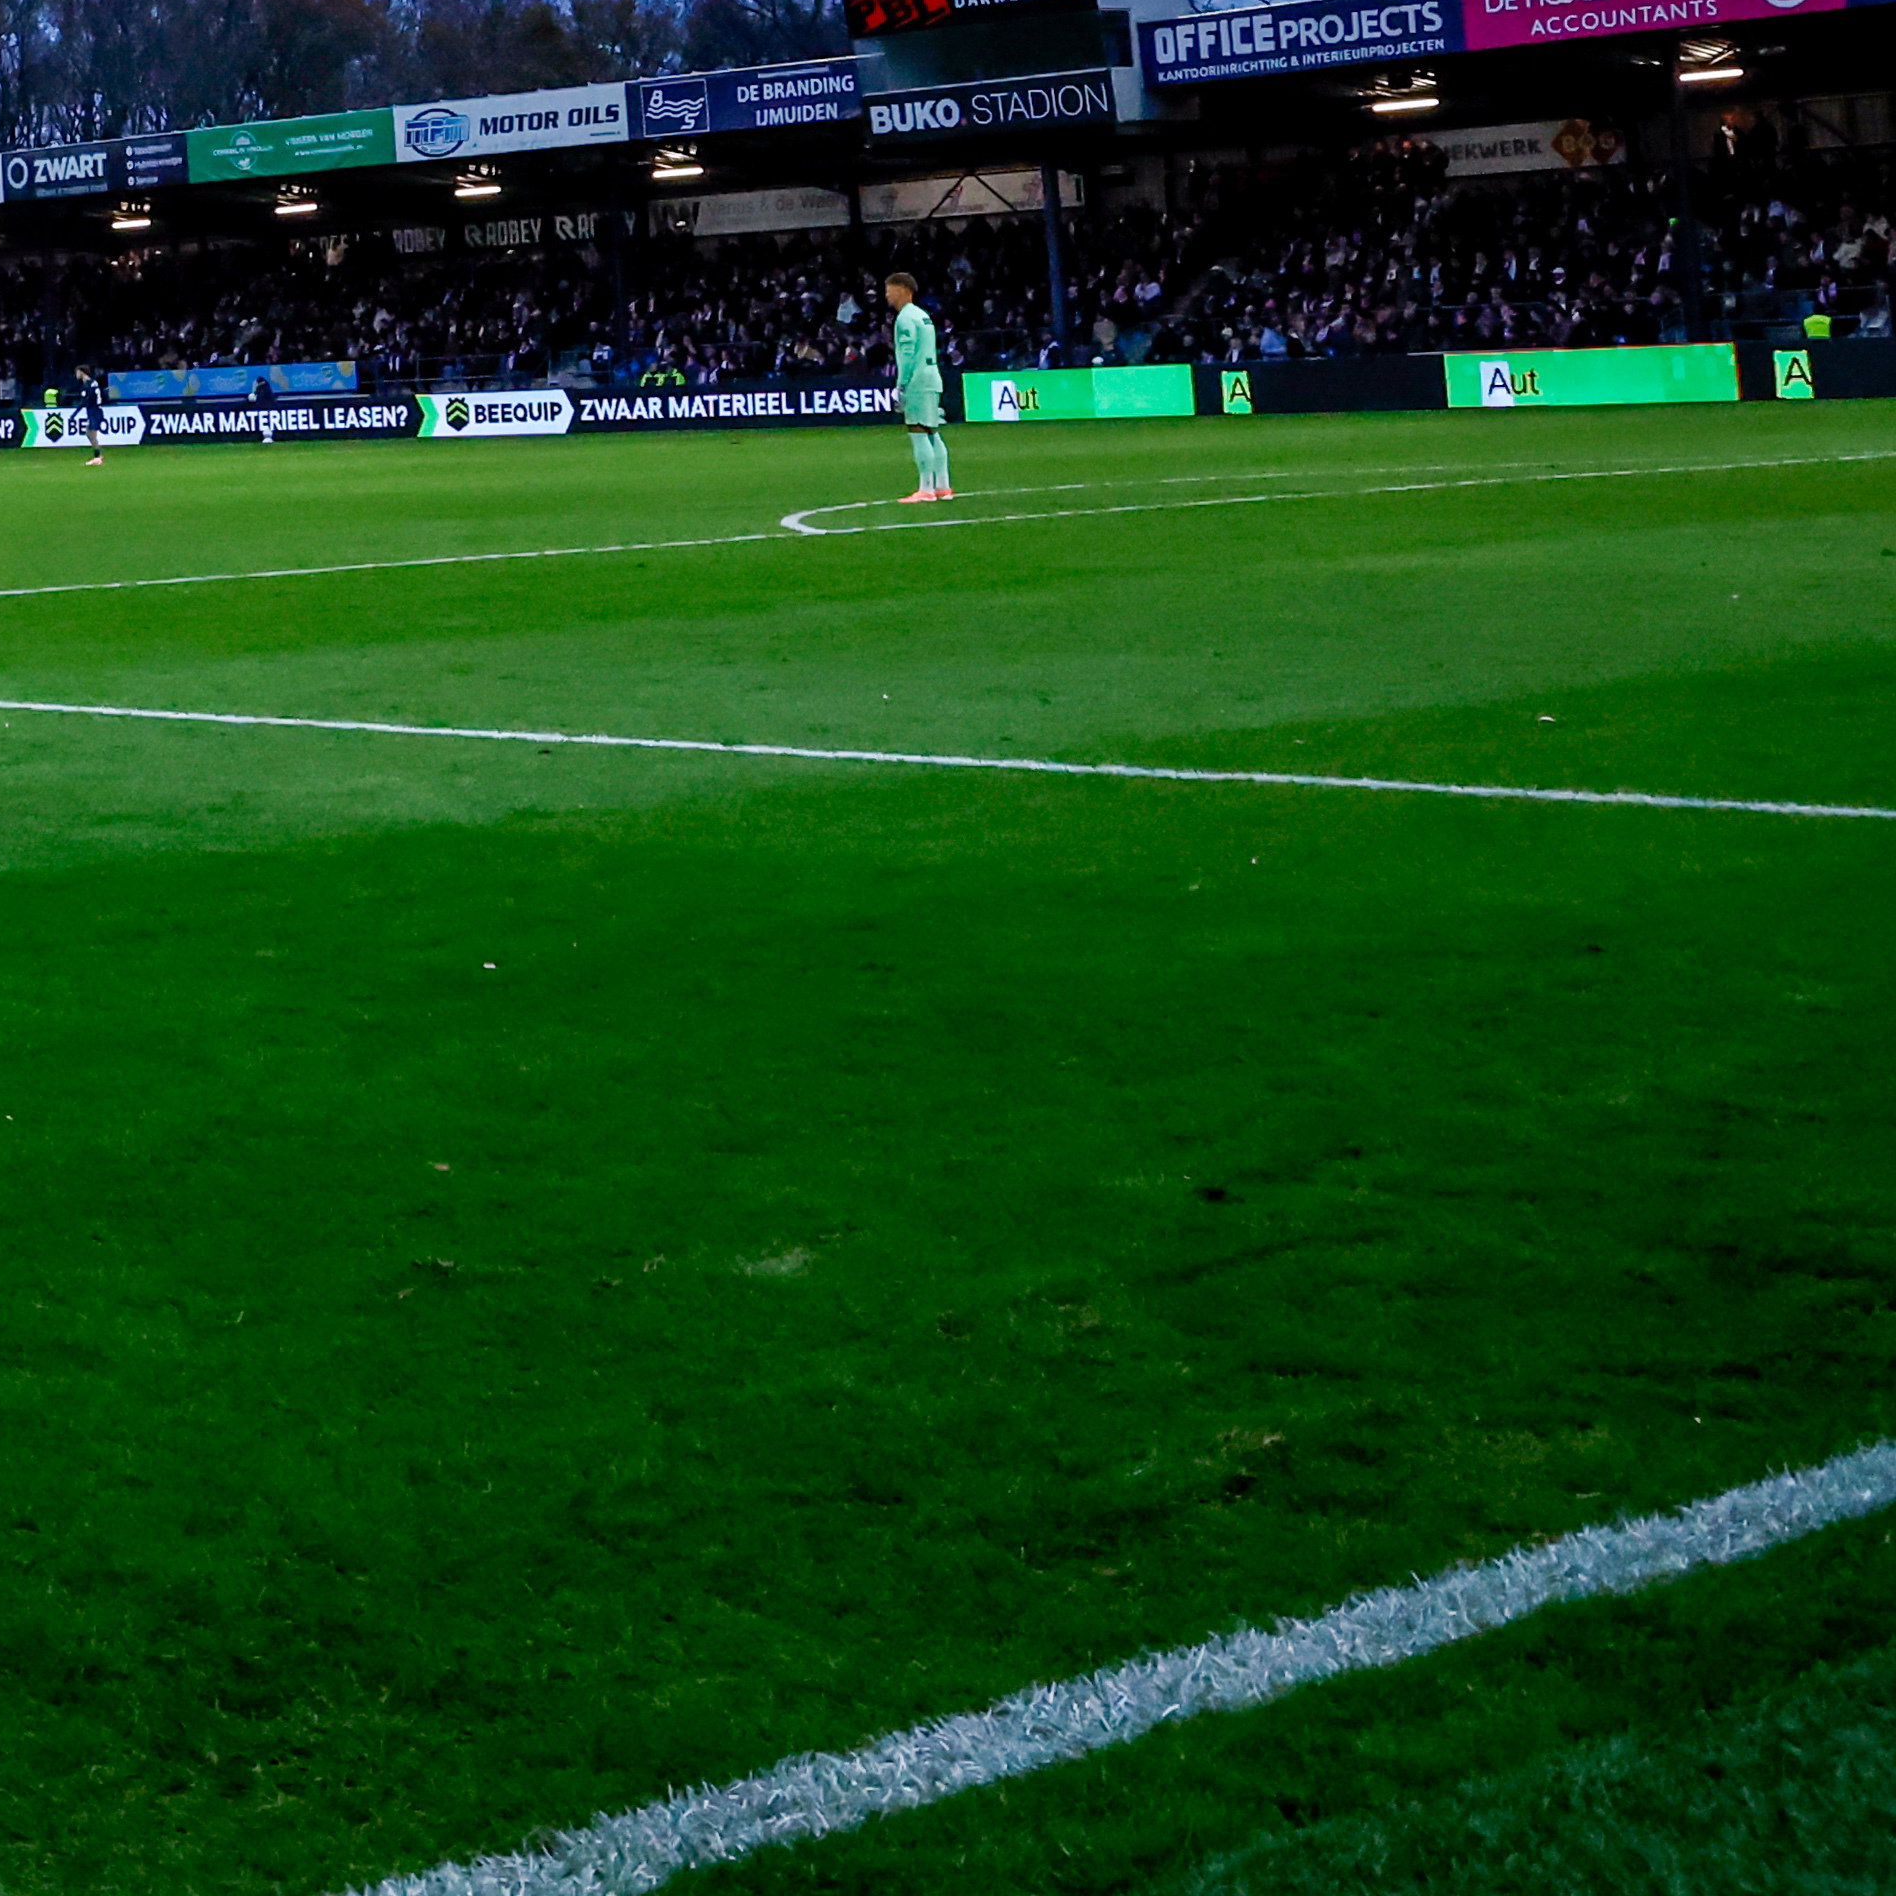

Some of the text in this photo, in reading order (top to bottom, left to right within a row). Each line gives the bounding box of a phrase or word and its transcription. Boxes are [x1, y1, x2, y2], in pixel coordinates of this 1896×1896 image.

[1531, 0, 1717, 36] ACCOUNTANTS
[1158, 38, 1444, 82] KANTOORINRICHTING & INTERIEURPROJECTEN
[737, 75, 854, 103] DE BRANDING
[972, 82, 1108, 125] STADION
[479, 104, 619, 136] MOTOR OILS
[1445, 138, 1542, 160] EKWERK
[34, 153, 107, 183] ZWART
[1488, 367, 1539, 395] Aut
[1785, 358, 1812, 385] A
[999, 386, 1039, 409] Aut
[1229, 378, 1251, 402] A
[69, 405, 408, 435] BEQUIP ZWAAR MATERIEEL LEASEN?
[475, 388, 899, 424] BEEQUIP ZWAAR MATERIEEL LEASEN
